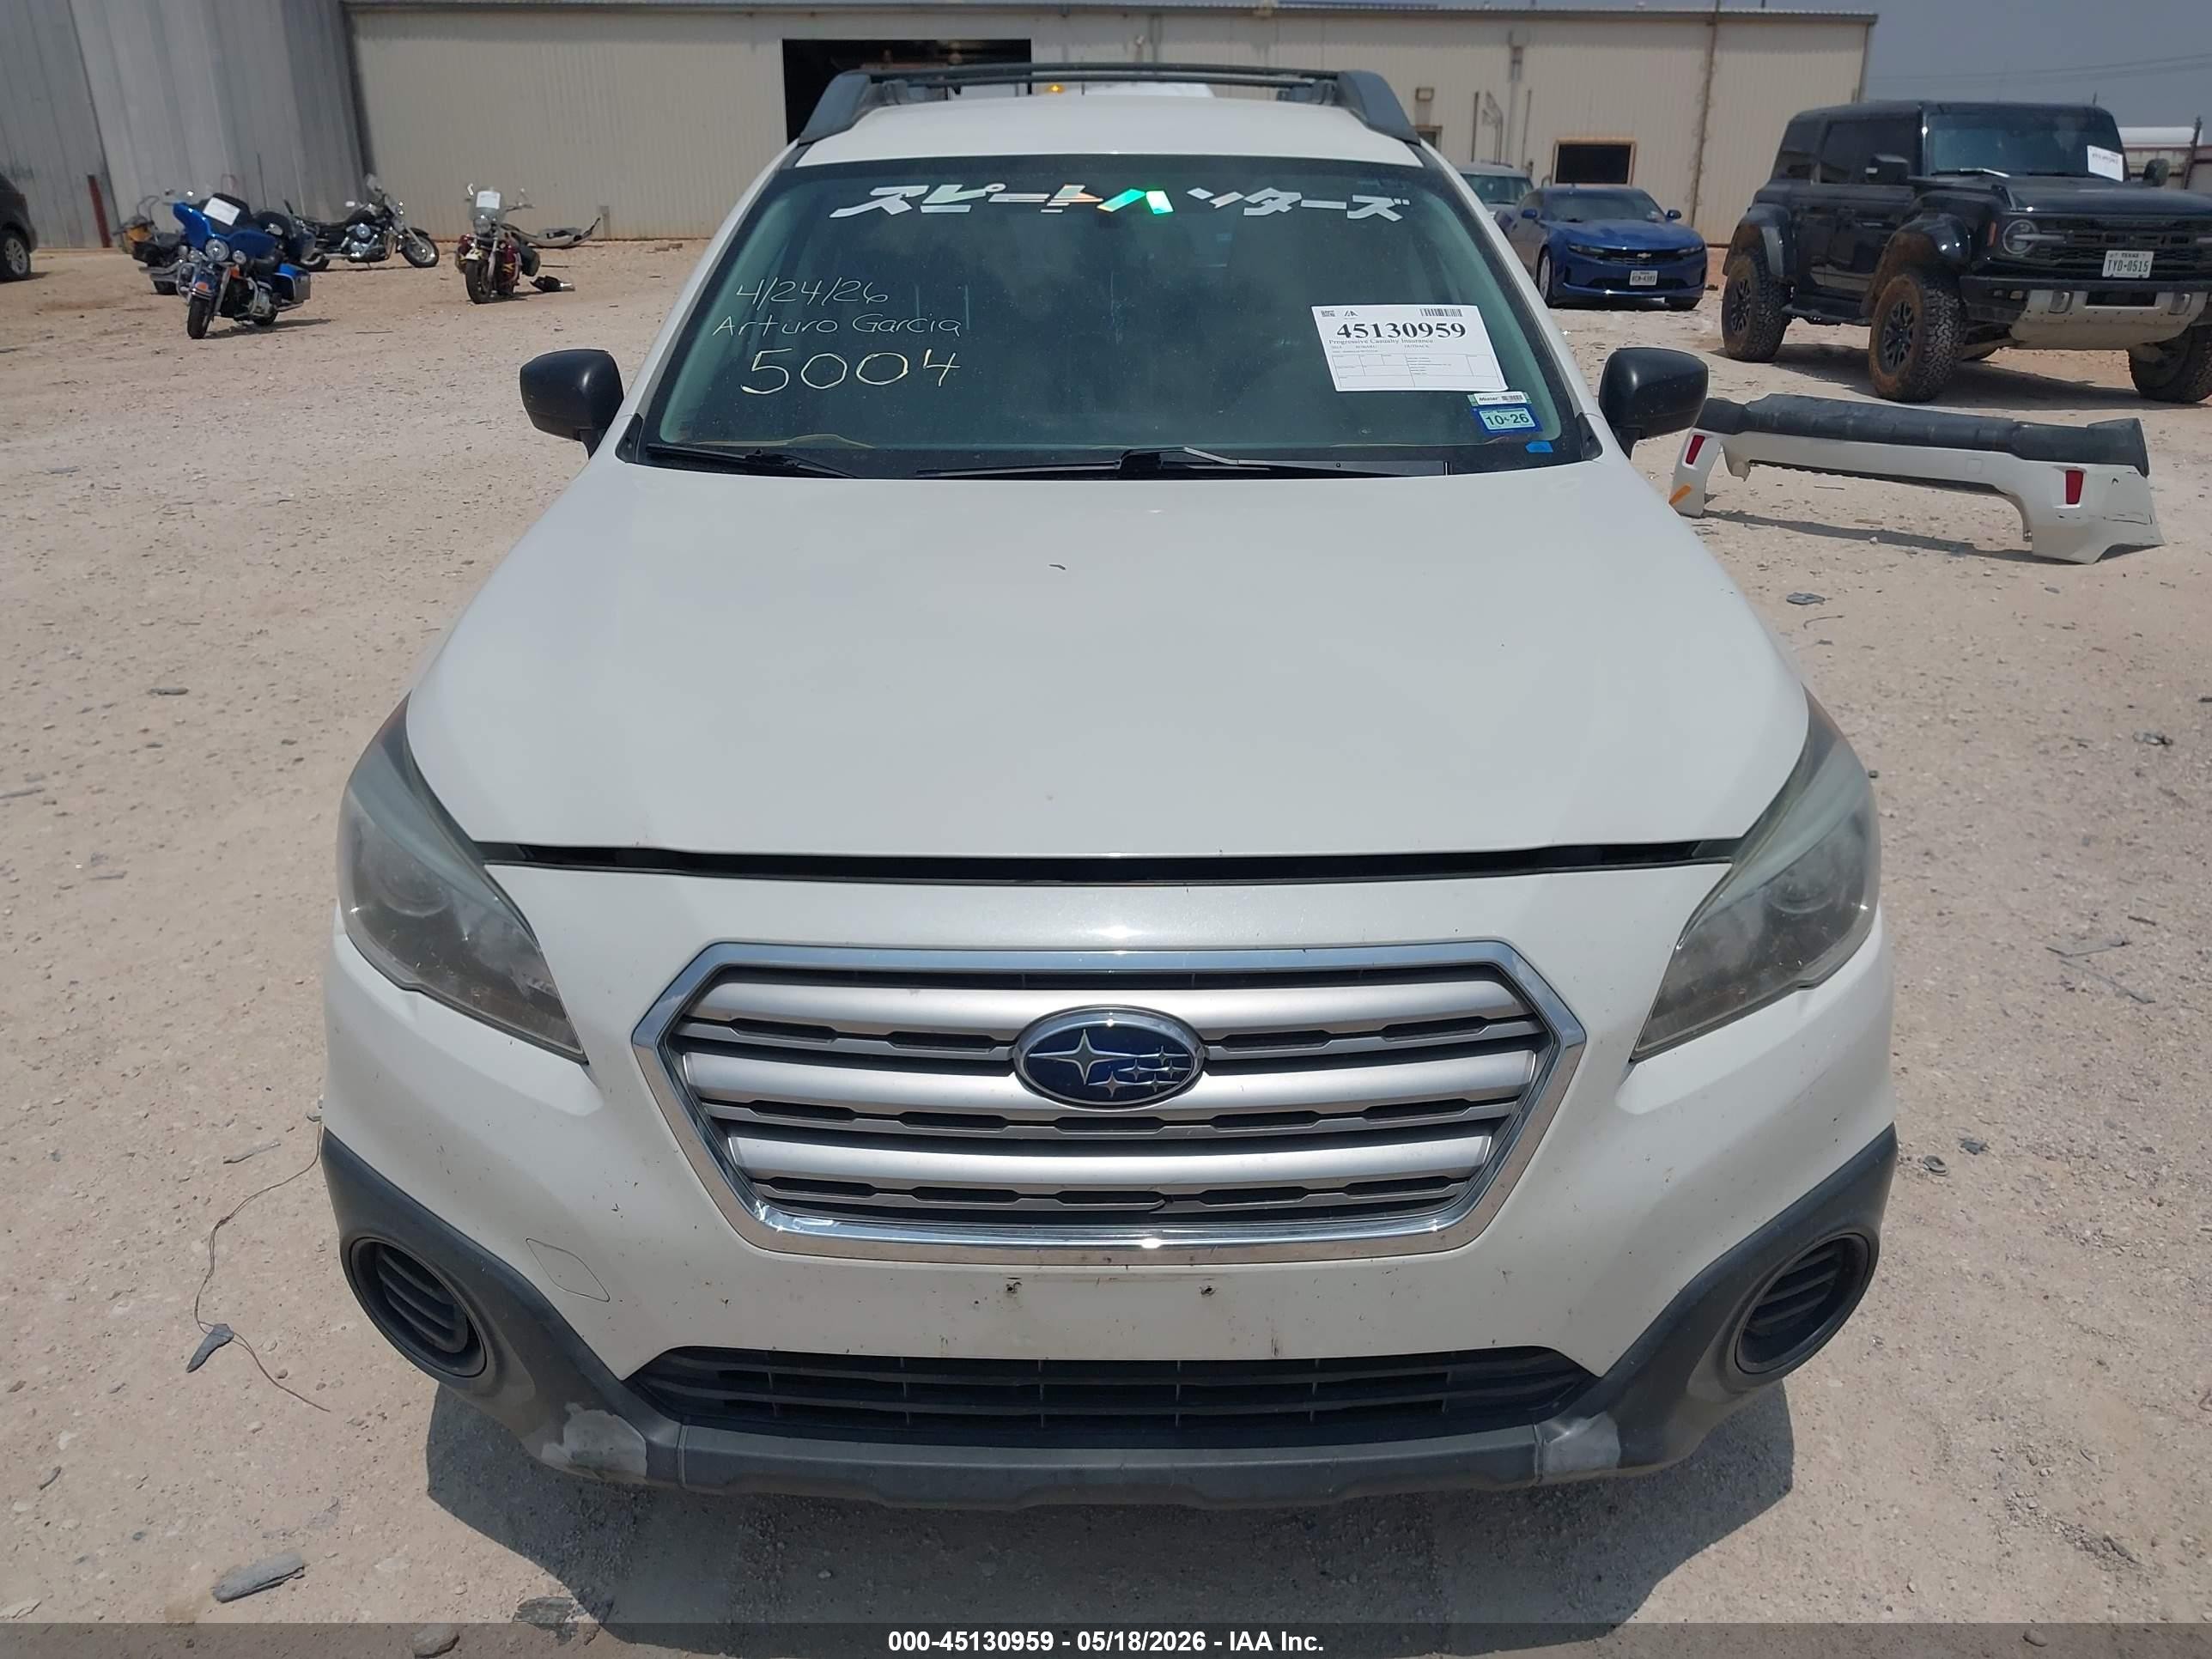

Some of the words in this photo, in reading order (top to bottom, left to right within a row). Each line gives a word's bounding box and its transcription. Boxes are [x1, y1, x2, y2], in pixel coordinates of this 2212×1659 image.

[736, 276, 889, 311] 4/24/26
[712, 314, 838, 337] Arturo
[852, 313, 961, 337] Garcia
[1337, 322, 1467, 339] 45130959
[740, 348, 961, 394] 5004
[1485, 415, 1504, 426] 10
[1510, 413, 1529, 424] 26
